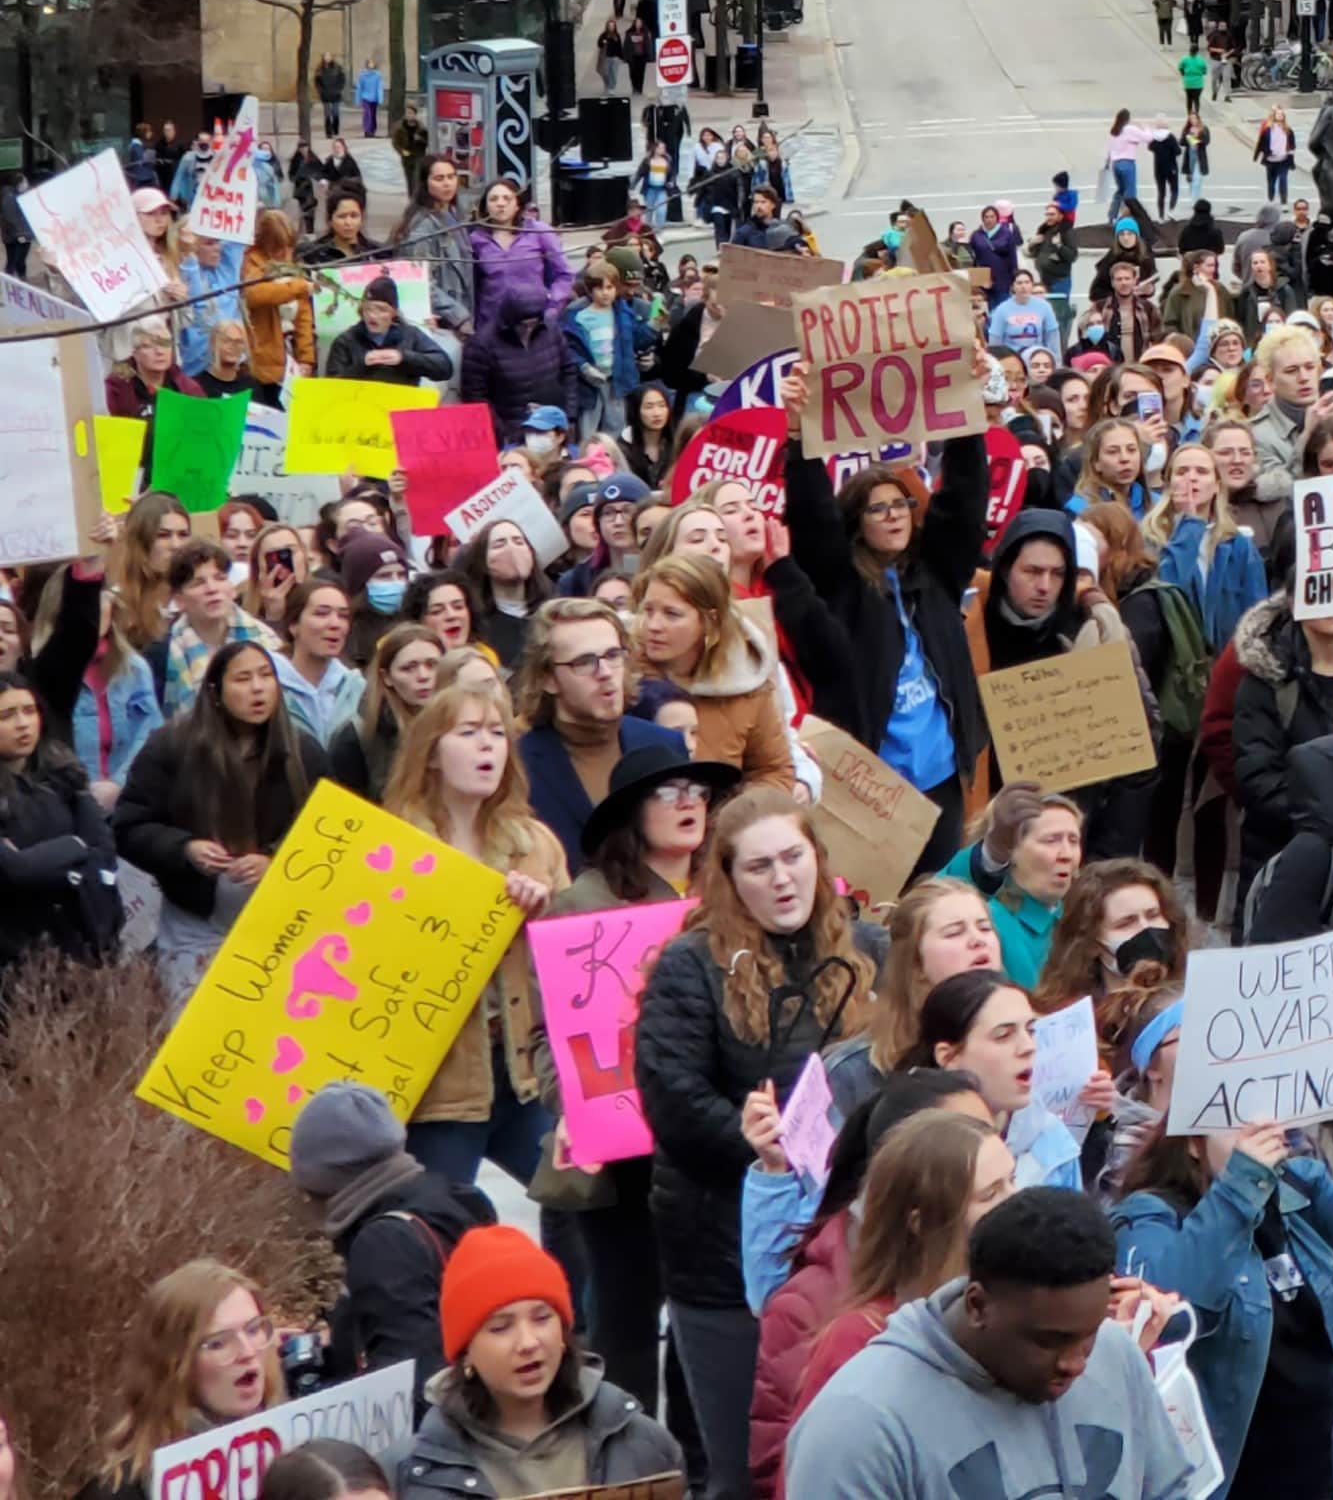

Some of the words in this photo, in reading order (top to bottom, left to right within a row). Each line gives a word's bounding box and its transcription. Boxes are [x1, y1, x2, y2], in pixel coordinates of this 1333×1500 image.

[801, 286, 951, 364] PROTECT
[820, 348, 967, 442] ROE
[698, 443, 747, 473] FOR
[459, 477, 518, 529] ABORTION
[1302, 492, 1326, 527] A
[149, 1028, 257, 1121] Keep
[215, 908, 313, 1003] Women
[283, 815, 364, 891] Safe
[413, 891, 513, 1033] Abortions
[349, 964, 423, 1039] Safe
